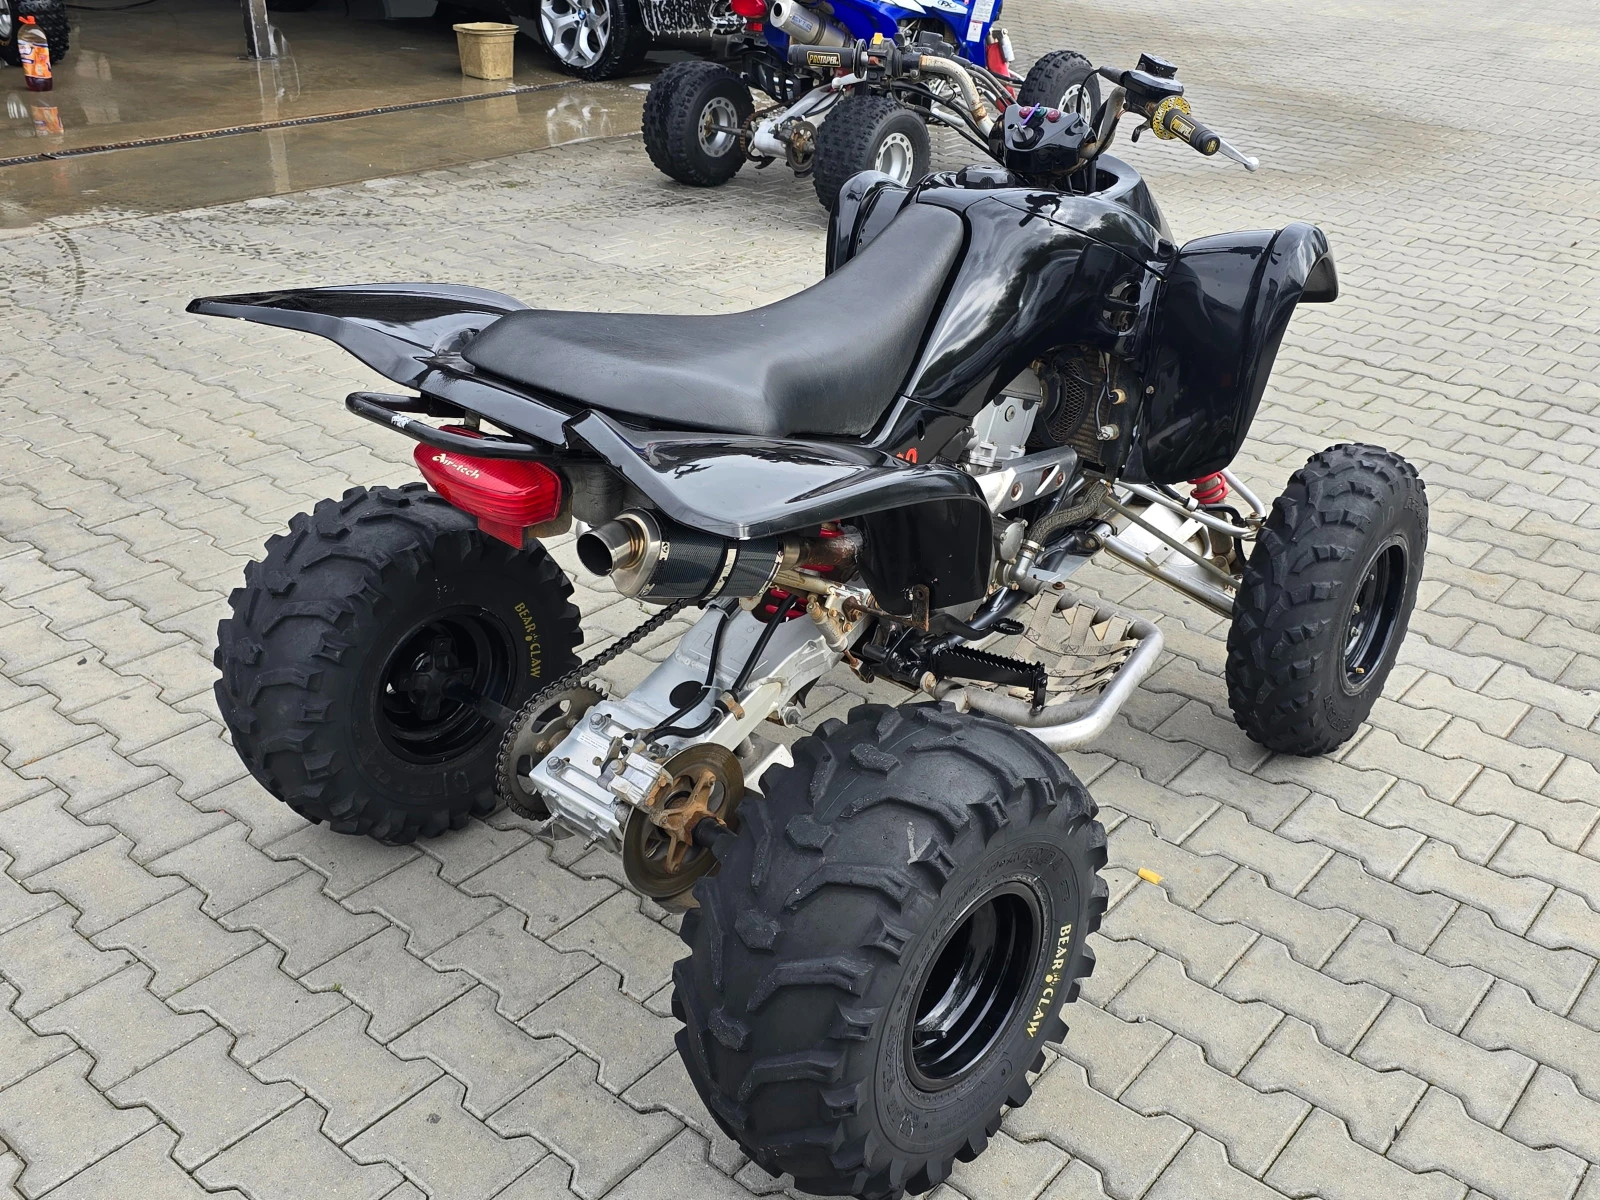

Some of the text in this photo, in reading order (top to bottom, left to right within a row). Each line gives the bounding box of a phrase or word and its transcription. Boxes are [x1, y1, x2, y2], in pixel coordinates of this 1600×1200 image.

[514, 602, 542, 678] BEAR CLAW
[1026, 923, 1072, 1038] BEAR CLAW
